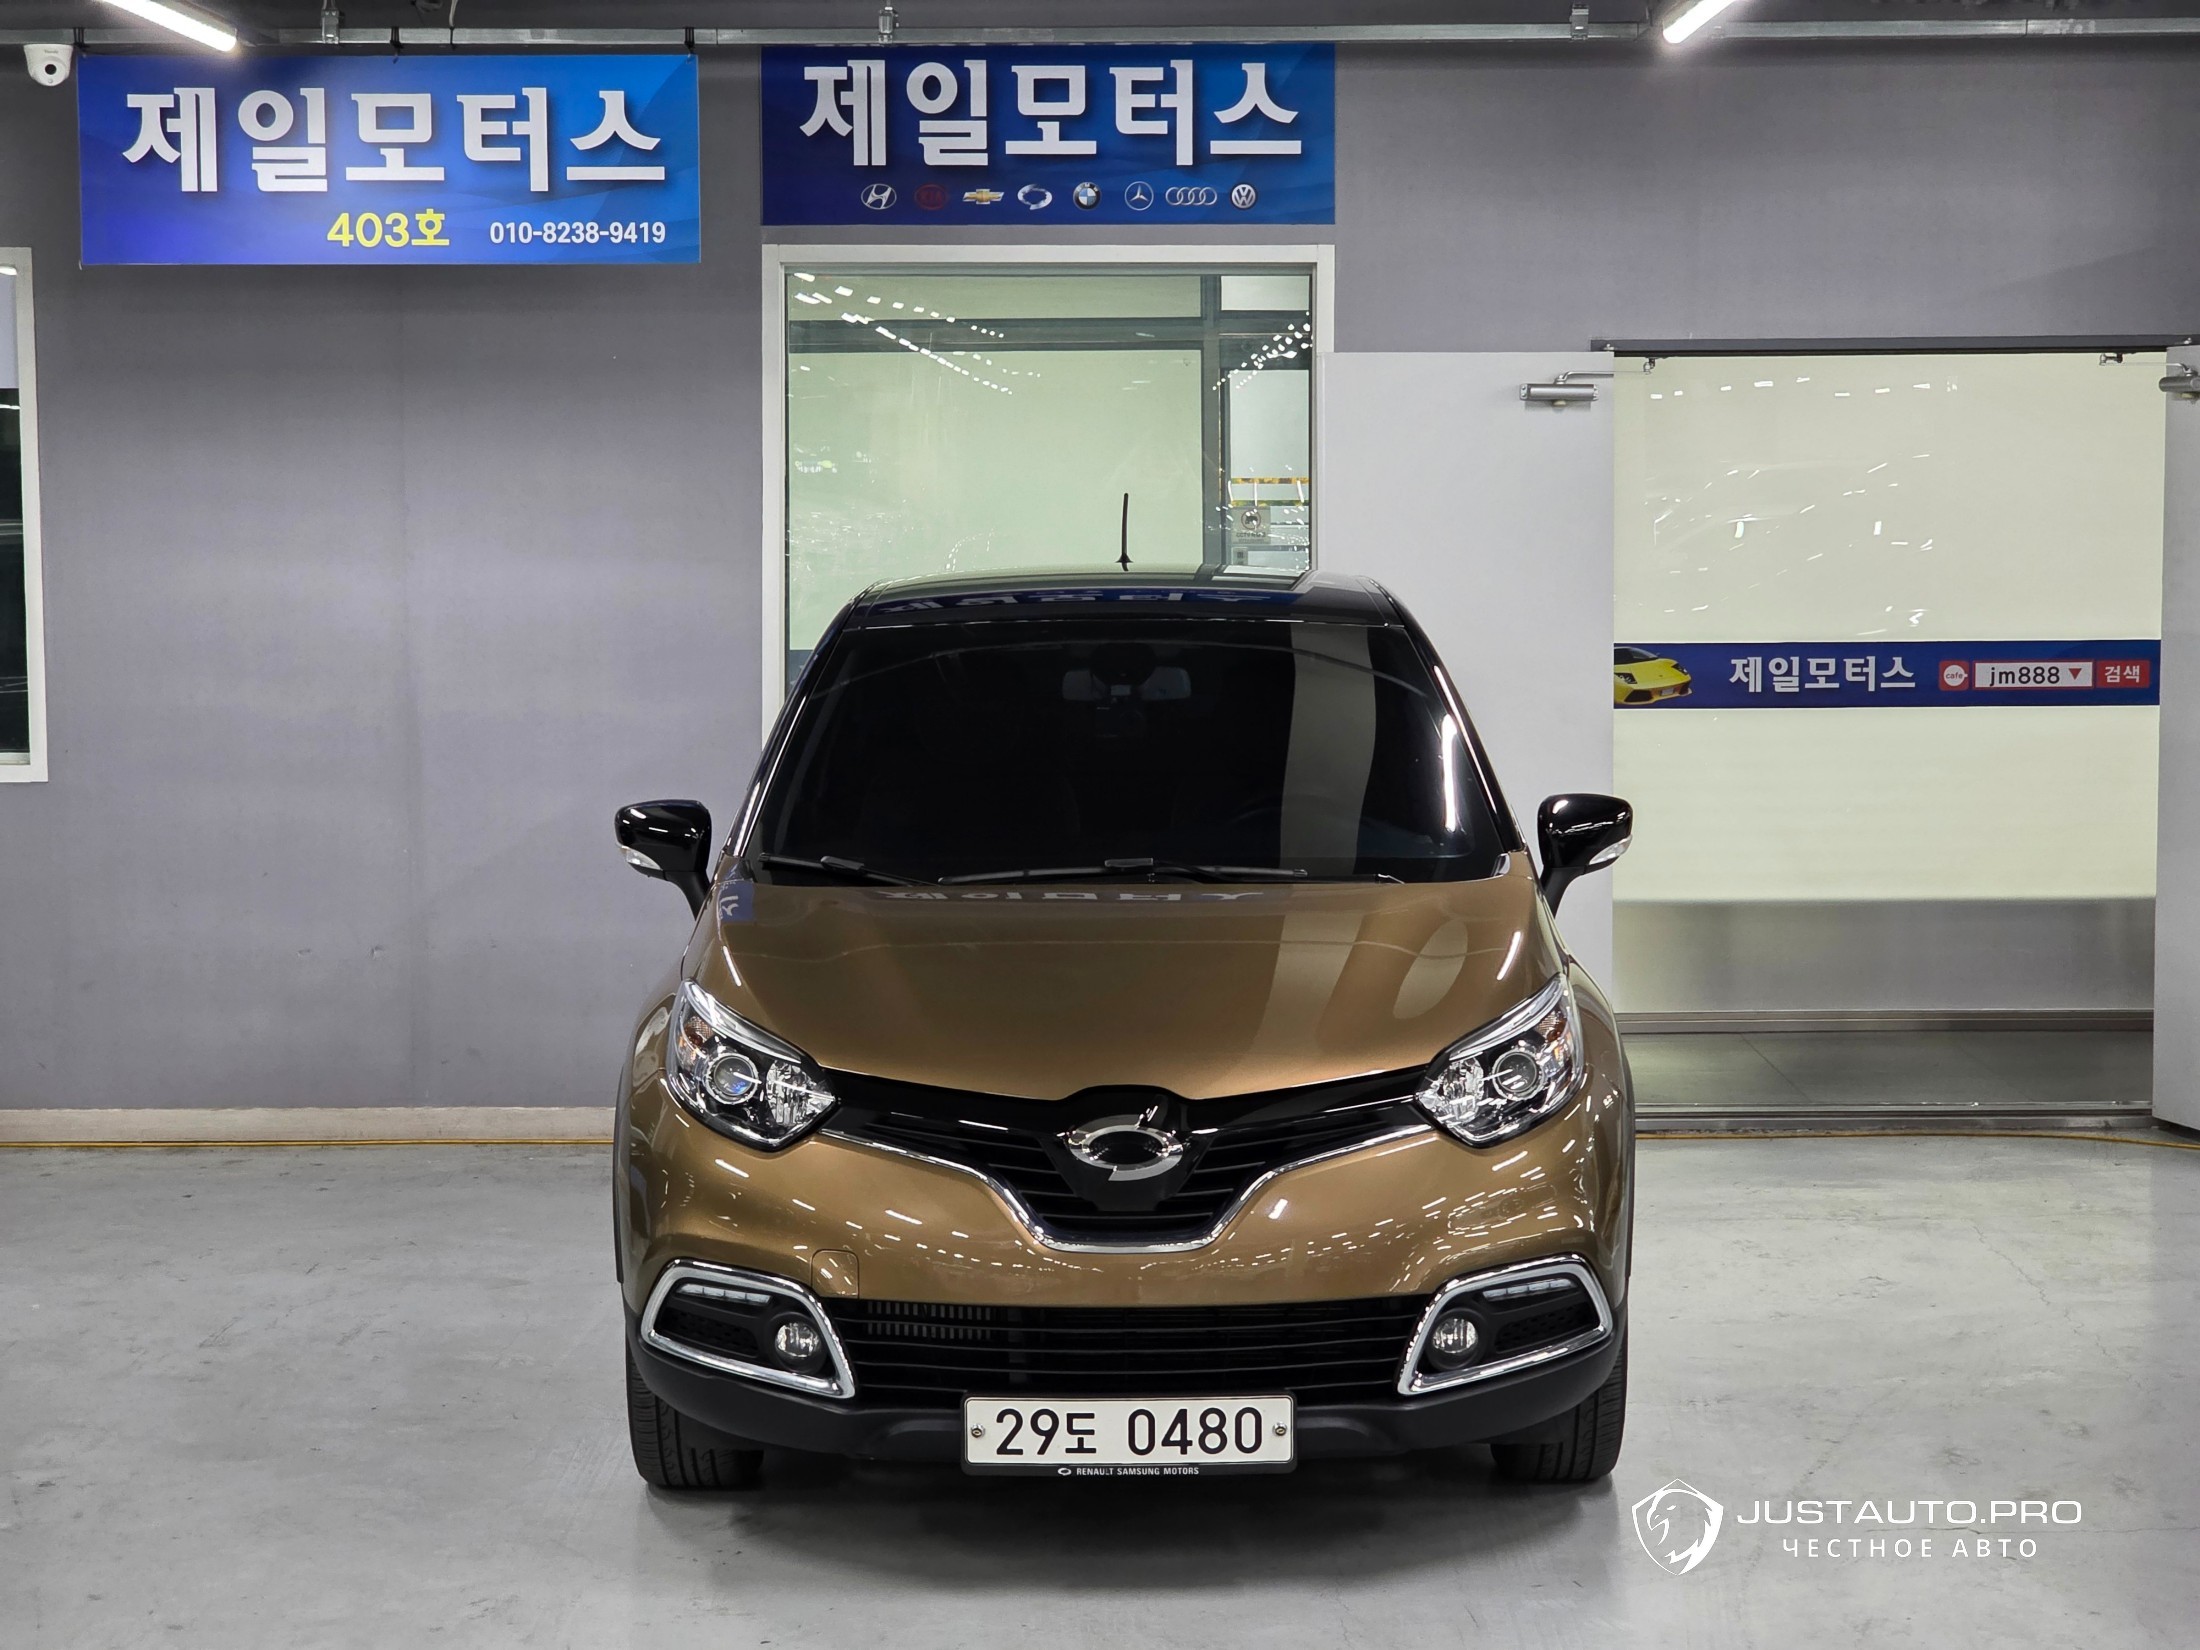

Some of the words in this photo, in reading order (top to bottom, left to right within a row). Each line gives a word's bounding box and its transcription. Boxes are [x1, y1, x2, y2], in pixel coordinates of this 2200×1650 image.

[798, 58, 1302, 167] 제일모터스
[122, 86, 666, 193] 제일모터스
[326, 208, 451, 248] 403호
[489, 220, 667, 245] 010-8238-9419
[1729, 656, 1916, 693] 제일모터스
[1945, 671, 1964, 680] cafe
[1989, 666, 2060, 687] jm888
[2104, 664, 2141, 683] 검색
[995, 1408, 1097, 1456] 29도
[1128, 1406, 1263, 1456] 0480
[1076, 1467, 1114, 1476] RENAULT
[1116, 1467, 1160, 1476] SAMSUNG
[1163, 1466, 1200, 1476] MOTORS
